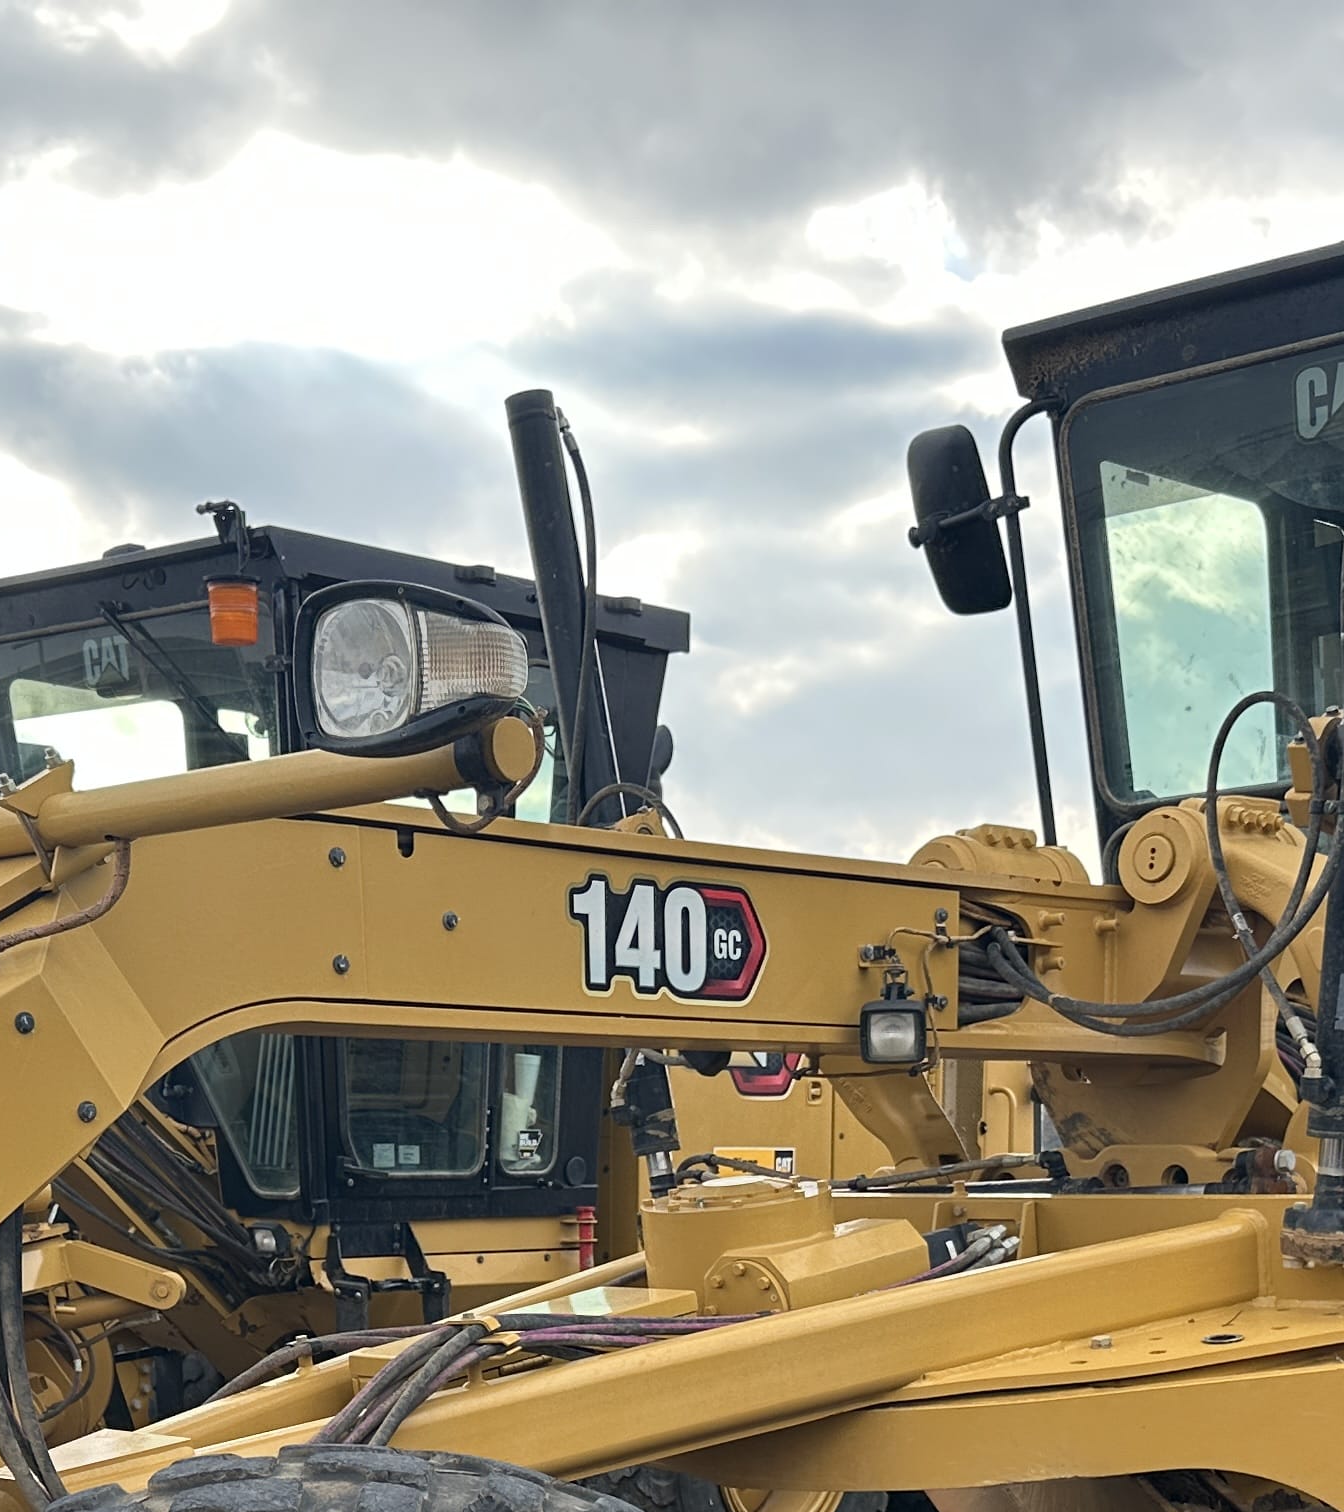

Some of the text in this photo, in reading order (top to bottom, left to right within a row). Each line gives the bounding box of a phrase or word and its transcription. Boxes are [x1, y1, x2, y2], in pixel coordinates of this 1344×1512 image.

[83, 635, 130, 685] CAT
[573, 880, 742, 993] 140 GC
